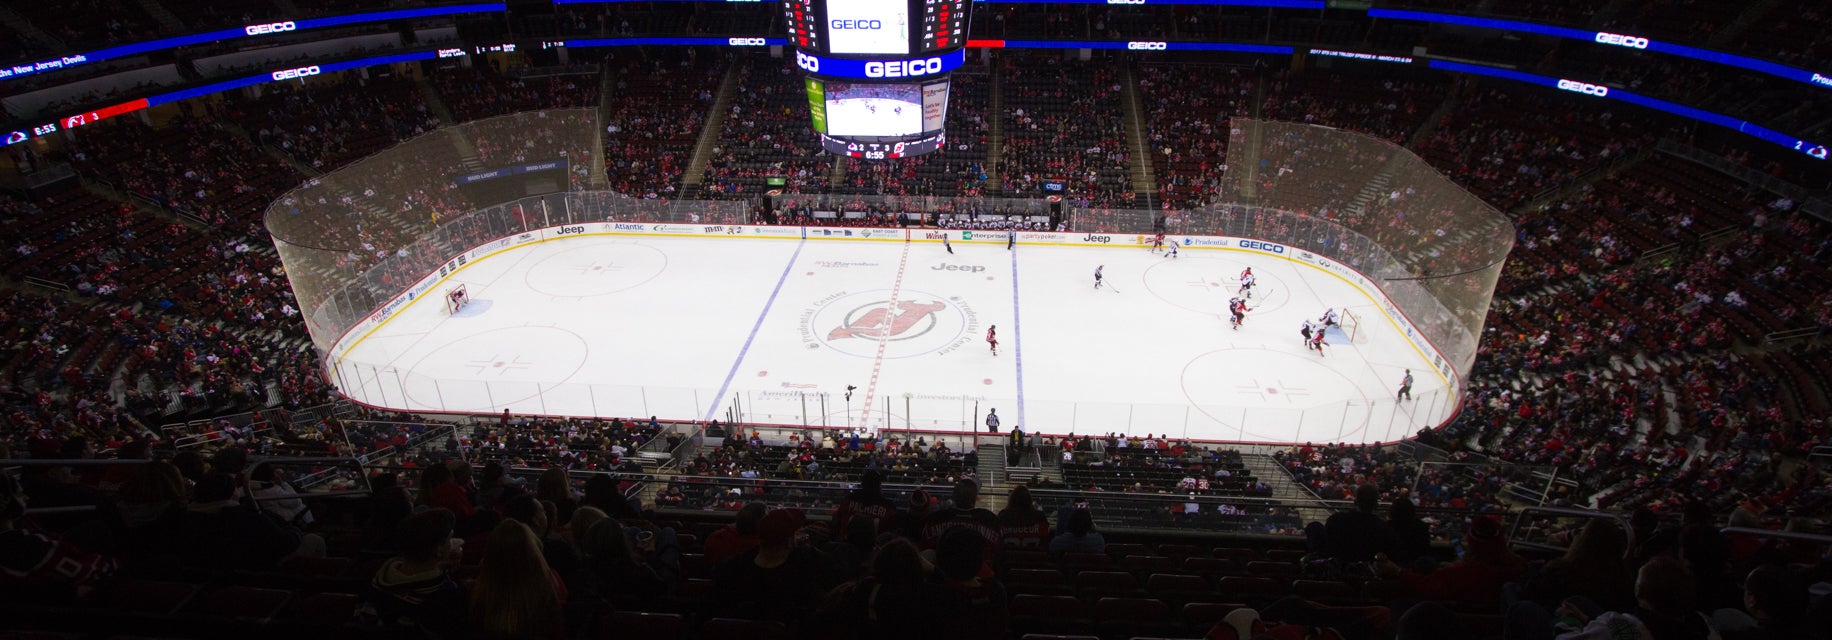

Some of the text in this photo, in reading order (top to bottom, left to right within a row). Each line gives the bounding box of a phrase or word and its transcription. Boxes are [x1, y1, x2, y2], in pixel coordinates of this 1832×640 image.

[245, 21, 296, 36] GEICO
[831, 19, 882, 30] GEICO
[729, 38, 766, 46] GEICO
[1594, 31, 1649, 50] GEICO
[1128, 42, 1167, 50] GEICO
[13, 65, 34, 75] New
[35, 59, 63, 71] Jersey
[62, 54, 87, 65] Devils
[865, 57, 942, 78] GEICO
[272, 65, 321, 81] GEICO
[1556, 78, 1608, 97] GEICO
[92, 112, 99, 121] 3
[884, 144, 890, 152] 3
[1794, 140, 1803, 150] 2
[866, 151, 884, 159] 6:55
[480, 171, 498, 180] LIGHT
[557, 224, 585, 236] Jeep
[614, 223, 644, 231] Atlantic
[1084, 234, 1111, 244] Jeep
[1195, 238, 1228, 247] Prudential
[1239, 240, 1284, 254] GEICO
[931, 263, 986, 273] Jeep
[813, 290, 847, 307] Center
[938, 336, 972, 357] Center
